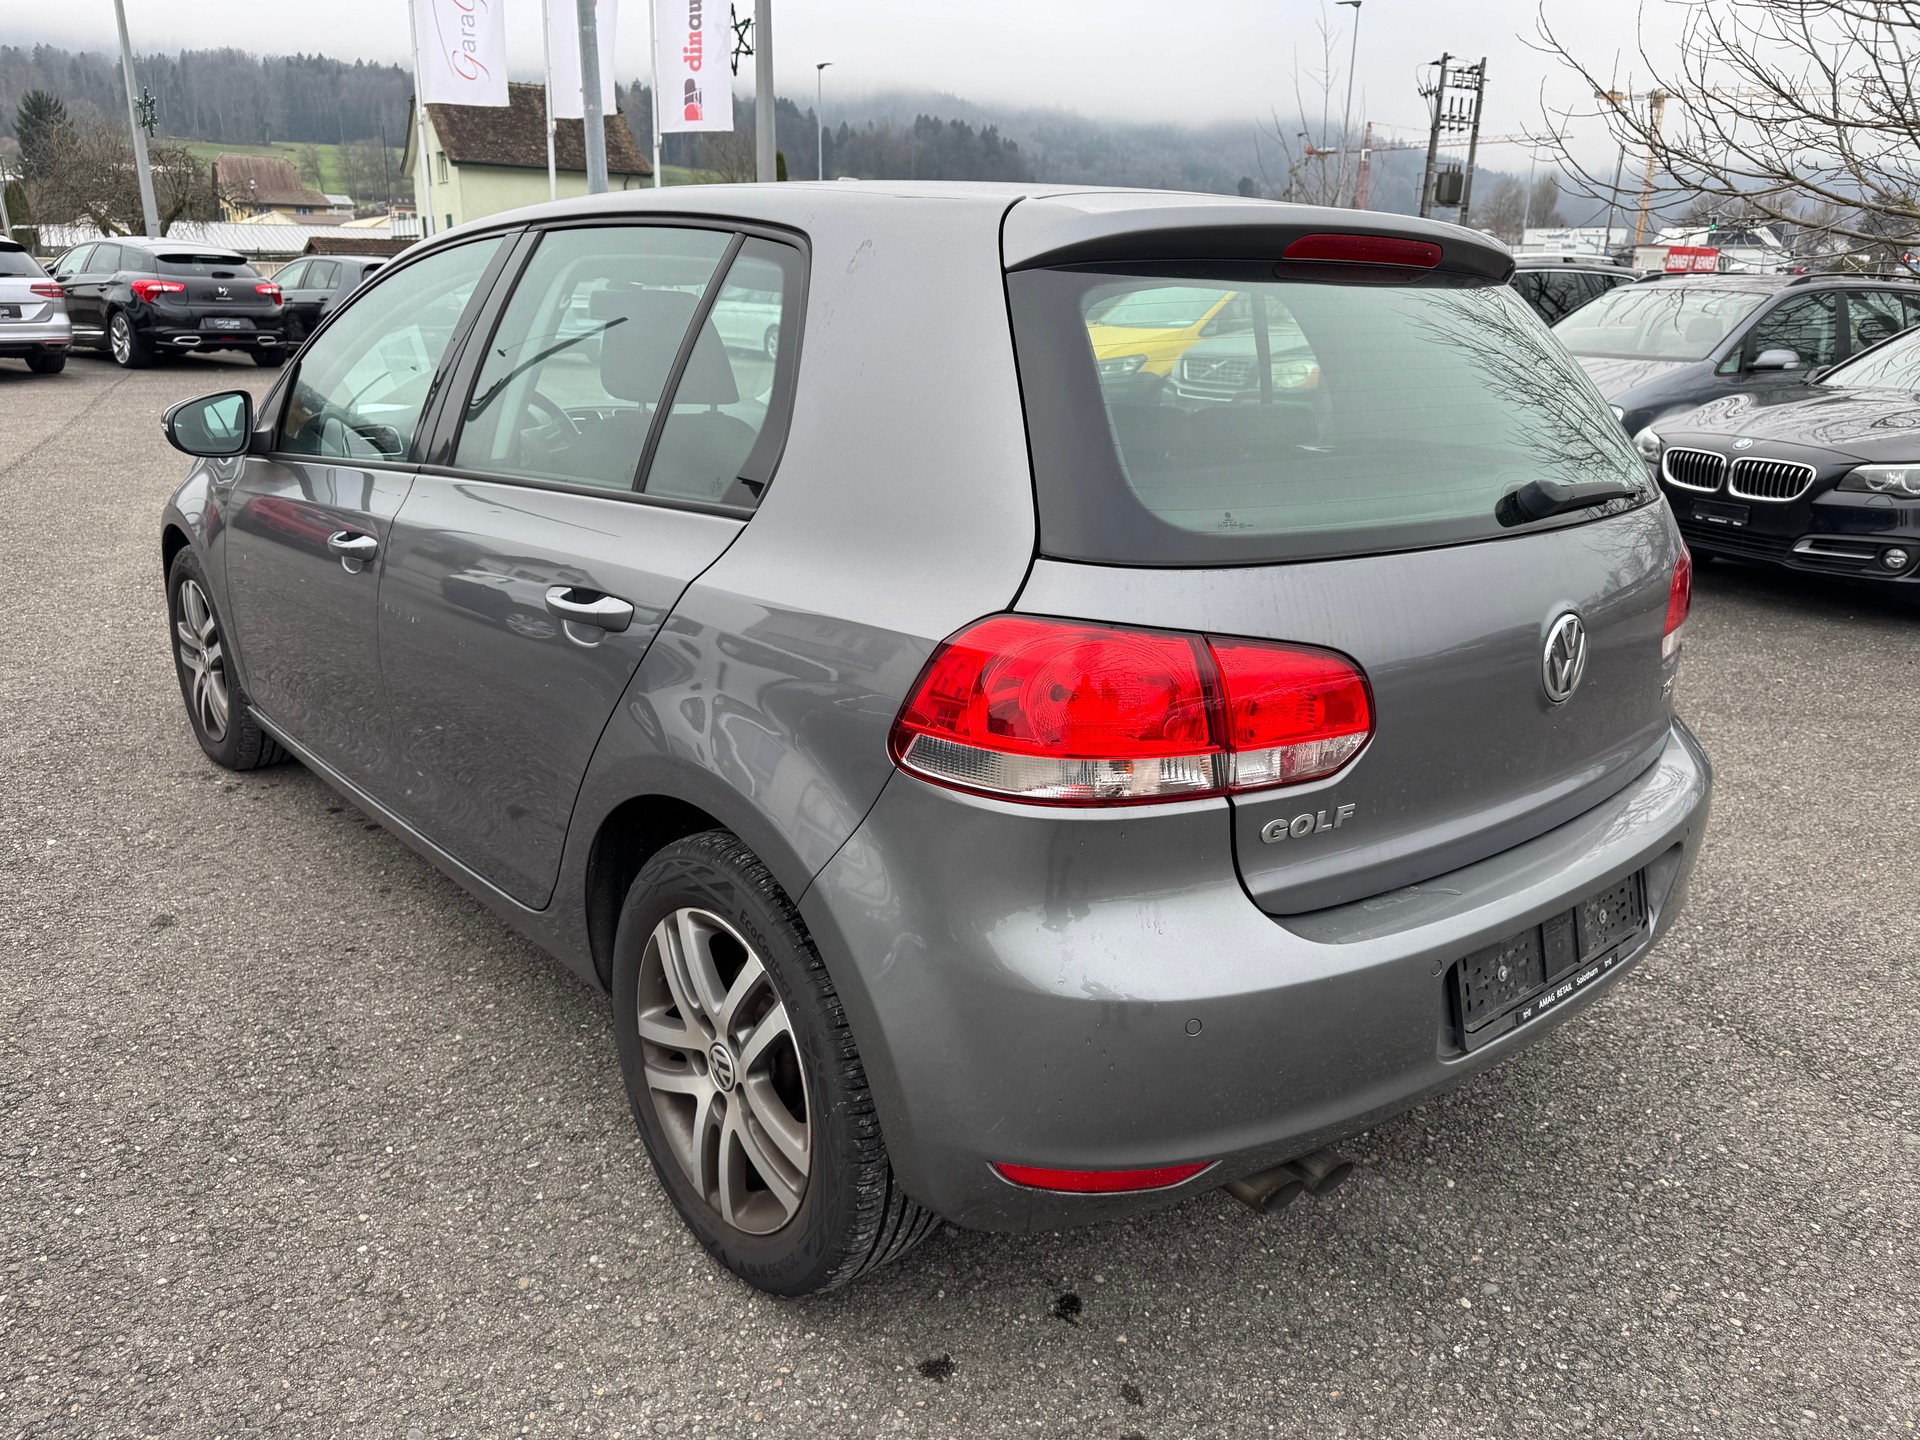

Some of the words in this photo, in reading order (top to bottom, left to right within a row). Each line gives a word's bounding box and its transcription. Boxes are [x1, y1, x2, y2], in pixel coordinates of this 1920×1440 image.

[1260, 803, 1356, 844] GOLF
[739, 909, 793, 999] EcoContact
[1538, 993, 1555, 1008] AMAG
[1556, 982, 1572, 997] RETAIL
[1576, 967, 1598, 985] Solothurn
